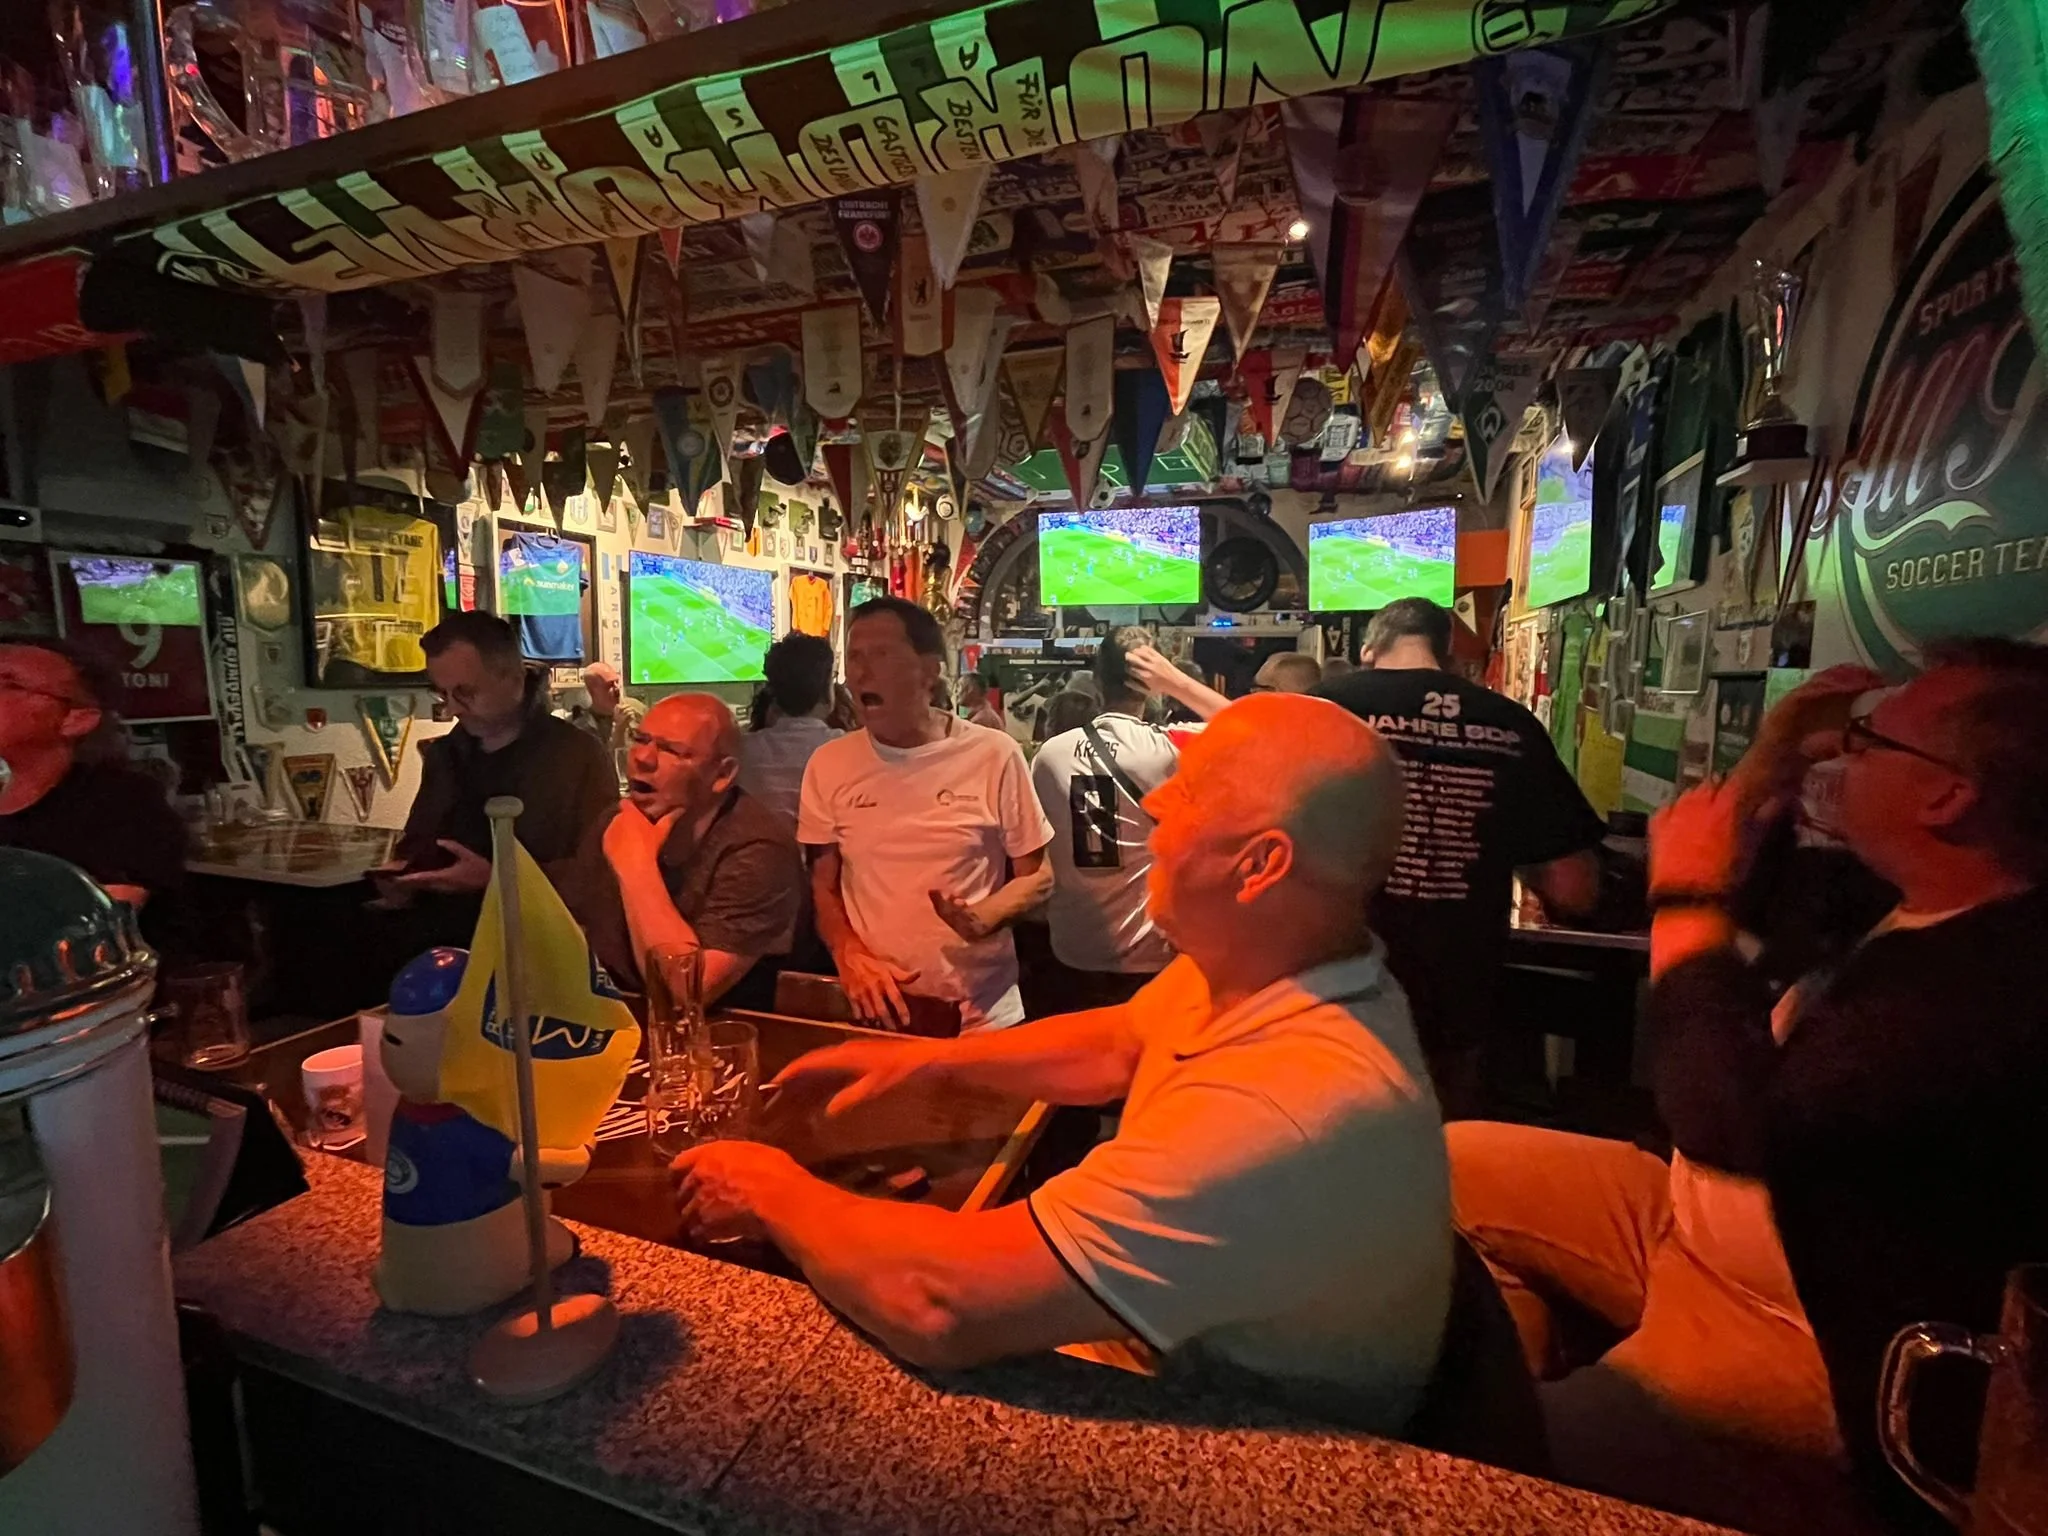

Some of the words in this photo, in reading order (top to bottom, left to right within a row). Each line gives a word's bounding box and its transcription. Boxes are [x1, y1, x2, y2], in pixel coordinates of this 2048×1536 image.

[1472, 378, 1516, 393] 2004
[1886, 547, 1984, 592] SOCCER
[116, 604, 165, 670] 9
[1421, 691, 1462, 719] 25
[1070, 774, 1120, 867] 8
